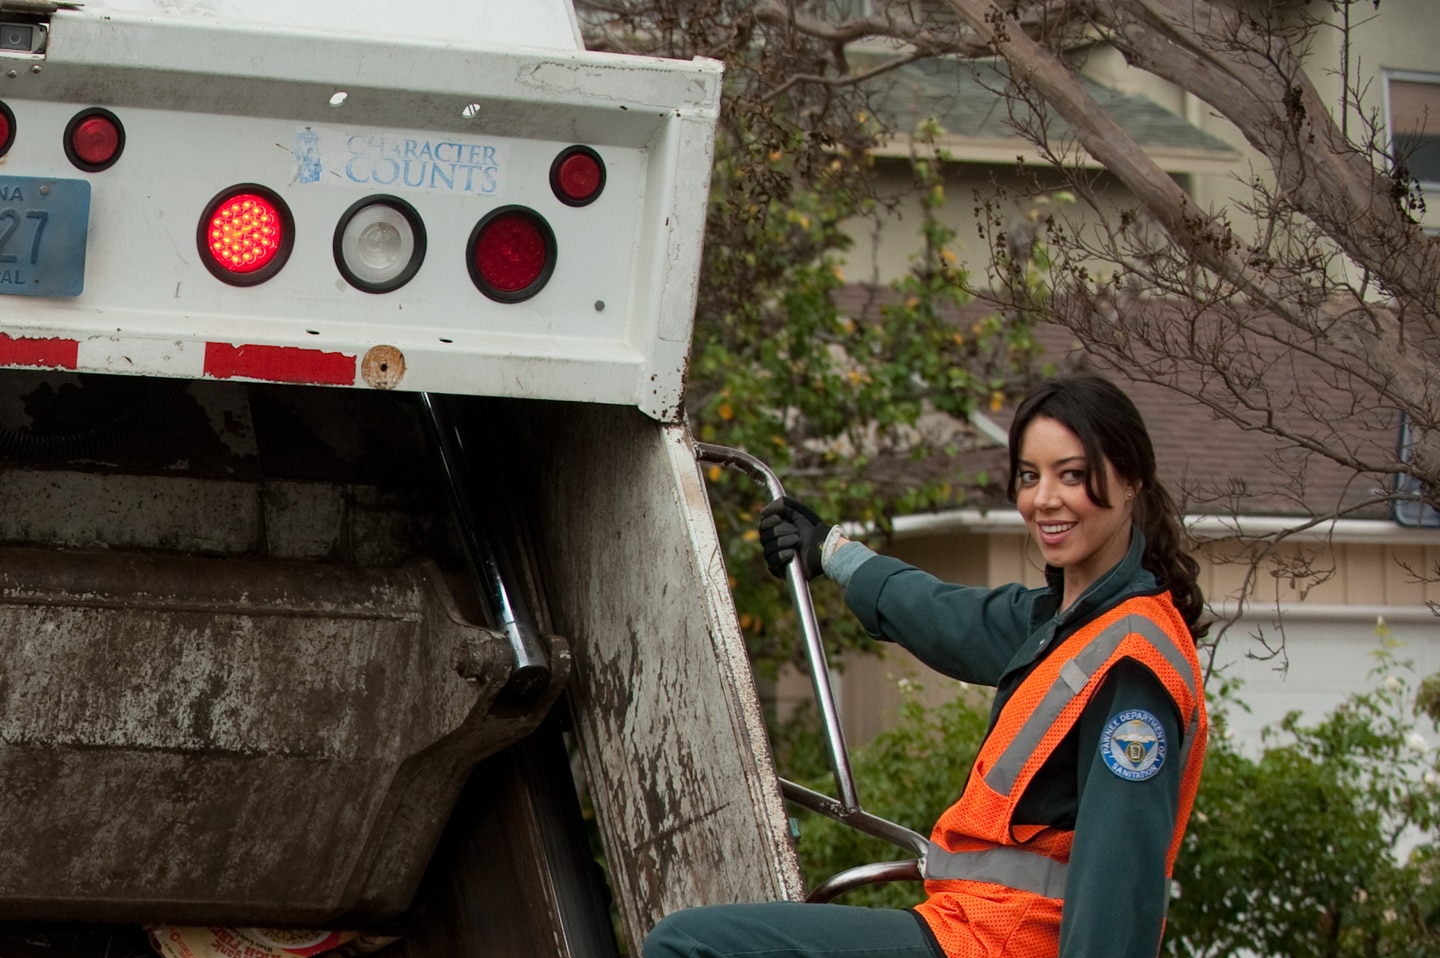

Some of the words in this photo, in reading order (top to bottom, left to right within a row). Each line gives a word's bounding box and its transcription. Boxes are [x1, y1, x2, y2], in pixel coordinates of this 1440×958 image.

[347, 134, 499, 167] CHARACTER
[345, 156, 499, 193] COUNTS
[1103, 719, 1121, 755] PAWNEE
[1120, 711, 1165, 741] DEPARTMENT
[1111, 762, 1158, 779] SANITATION
